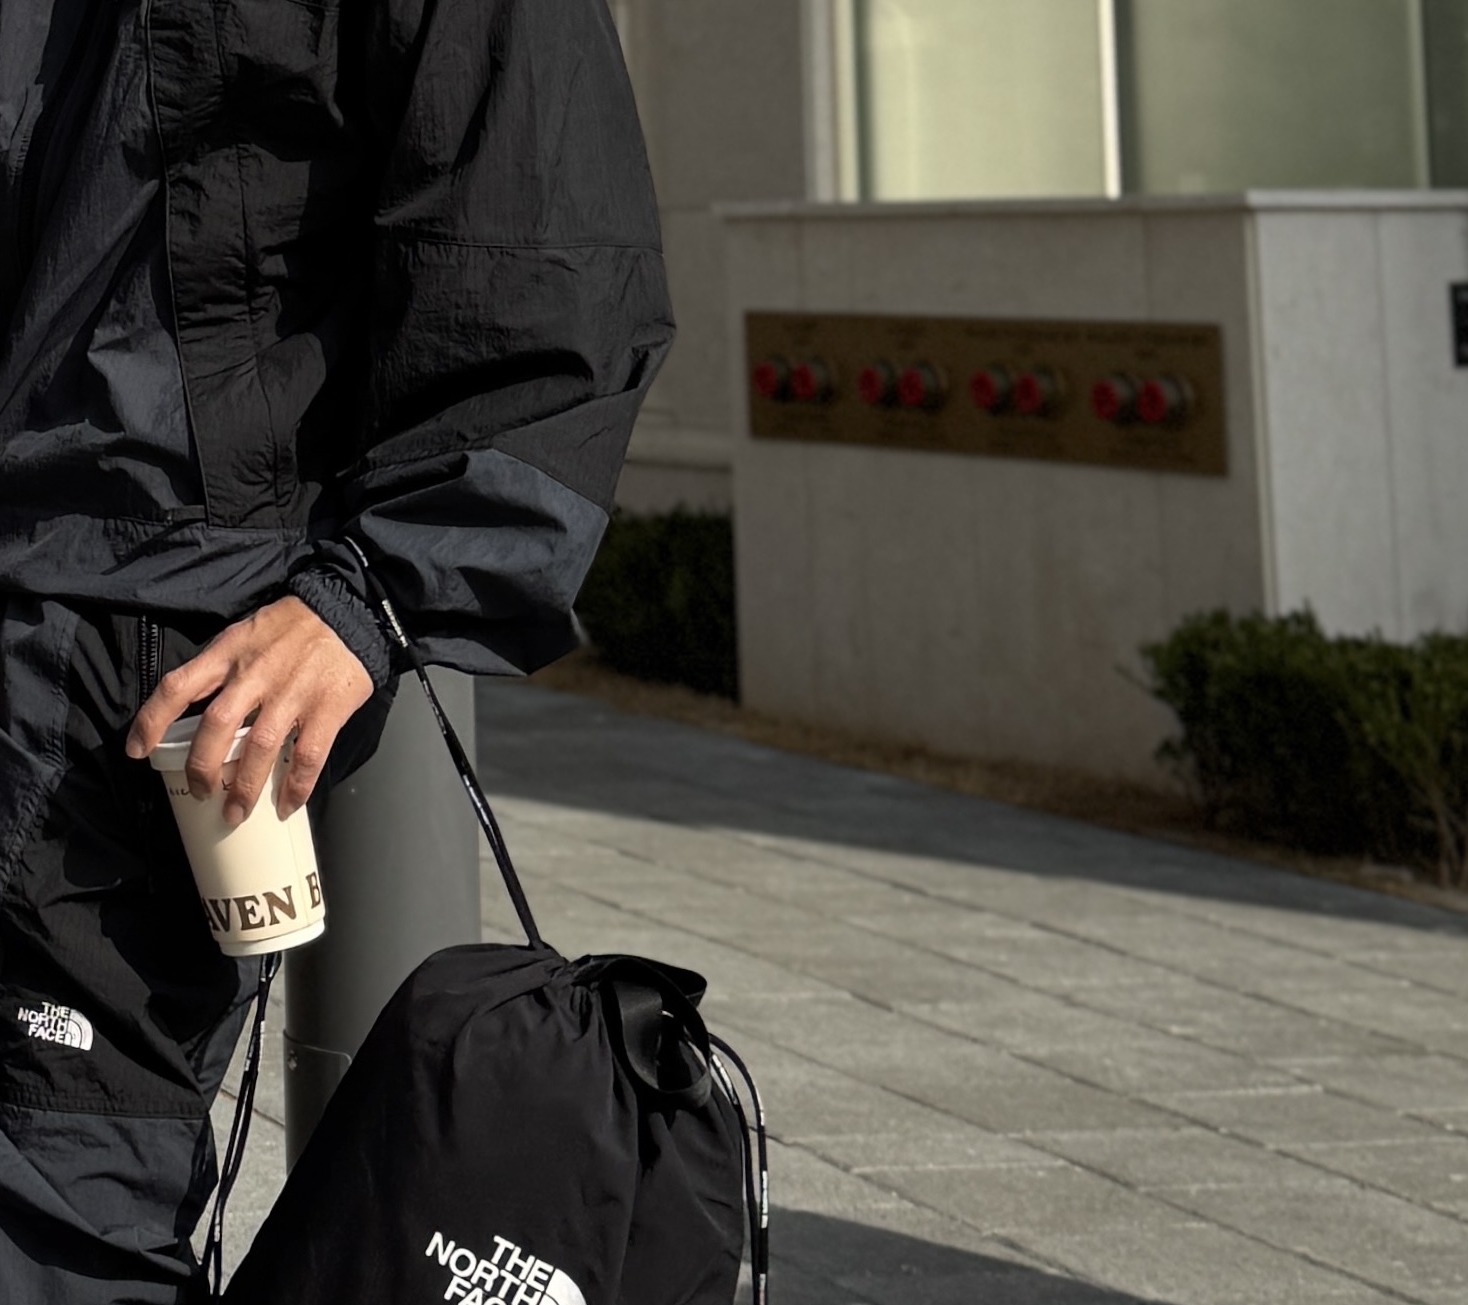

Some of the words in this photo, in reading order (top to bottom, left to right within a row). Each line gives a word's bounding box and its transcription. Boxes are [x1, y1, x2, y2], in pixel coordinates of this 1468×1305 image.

[17, 1006, 68, 1034] NORTH
[41, 1001, 70, 1019] THE
[28, 1023, 66, 1043] FACE
[491, 1234, 556, 1291] THE
